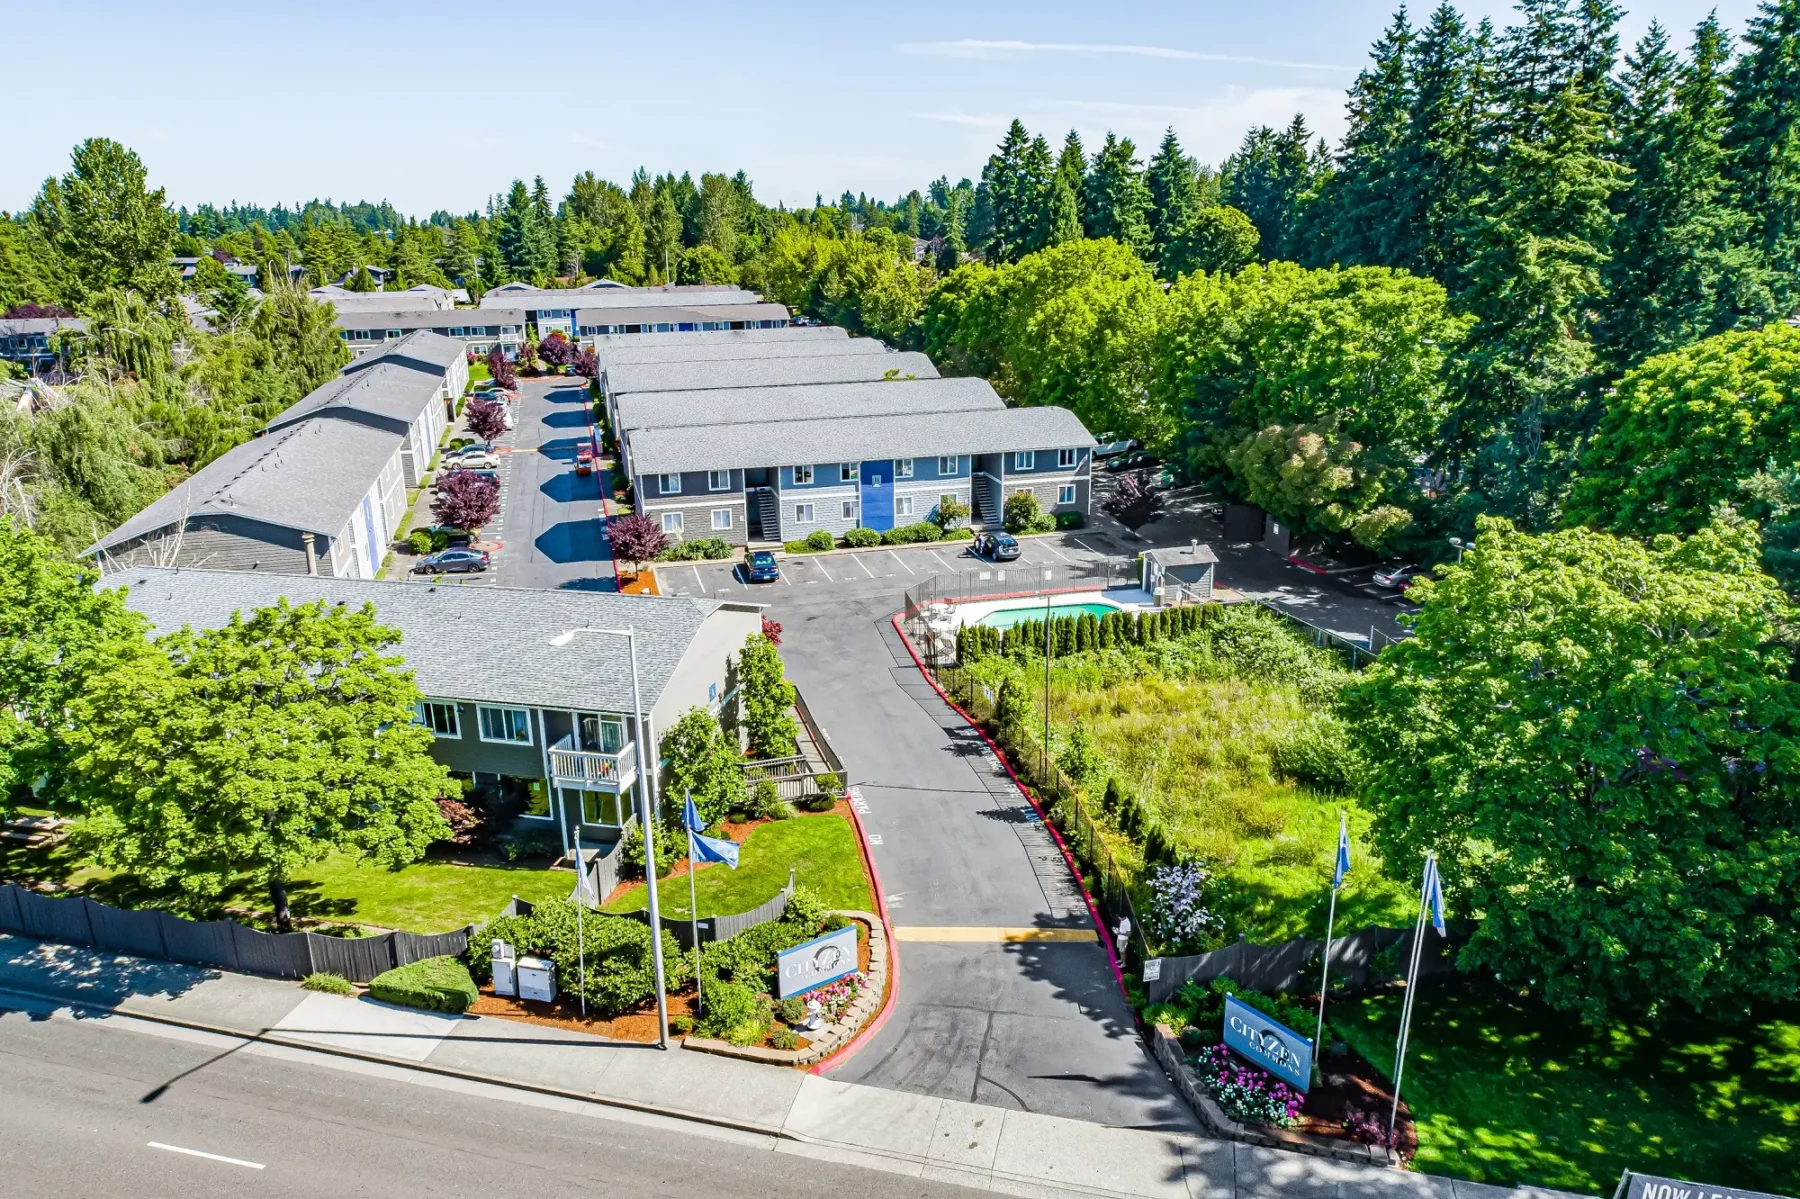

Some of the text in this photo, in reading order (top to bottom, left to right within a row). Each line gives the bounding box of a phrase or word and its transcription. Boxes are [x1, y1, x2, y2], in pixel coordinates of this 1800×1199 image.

[847, 786, 884, 845] NO PARKING
[1248, 1041, 1300, 1077] COMMONS
